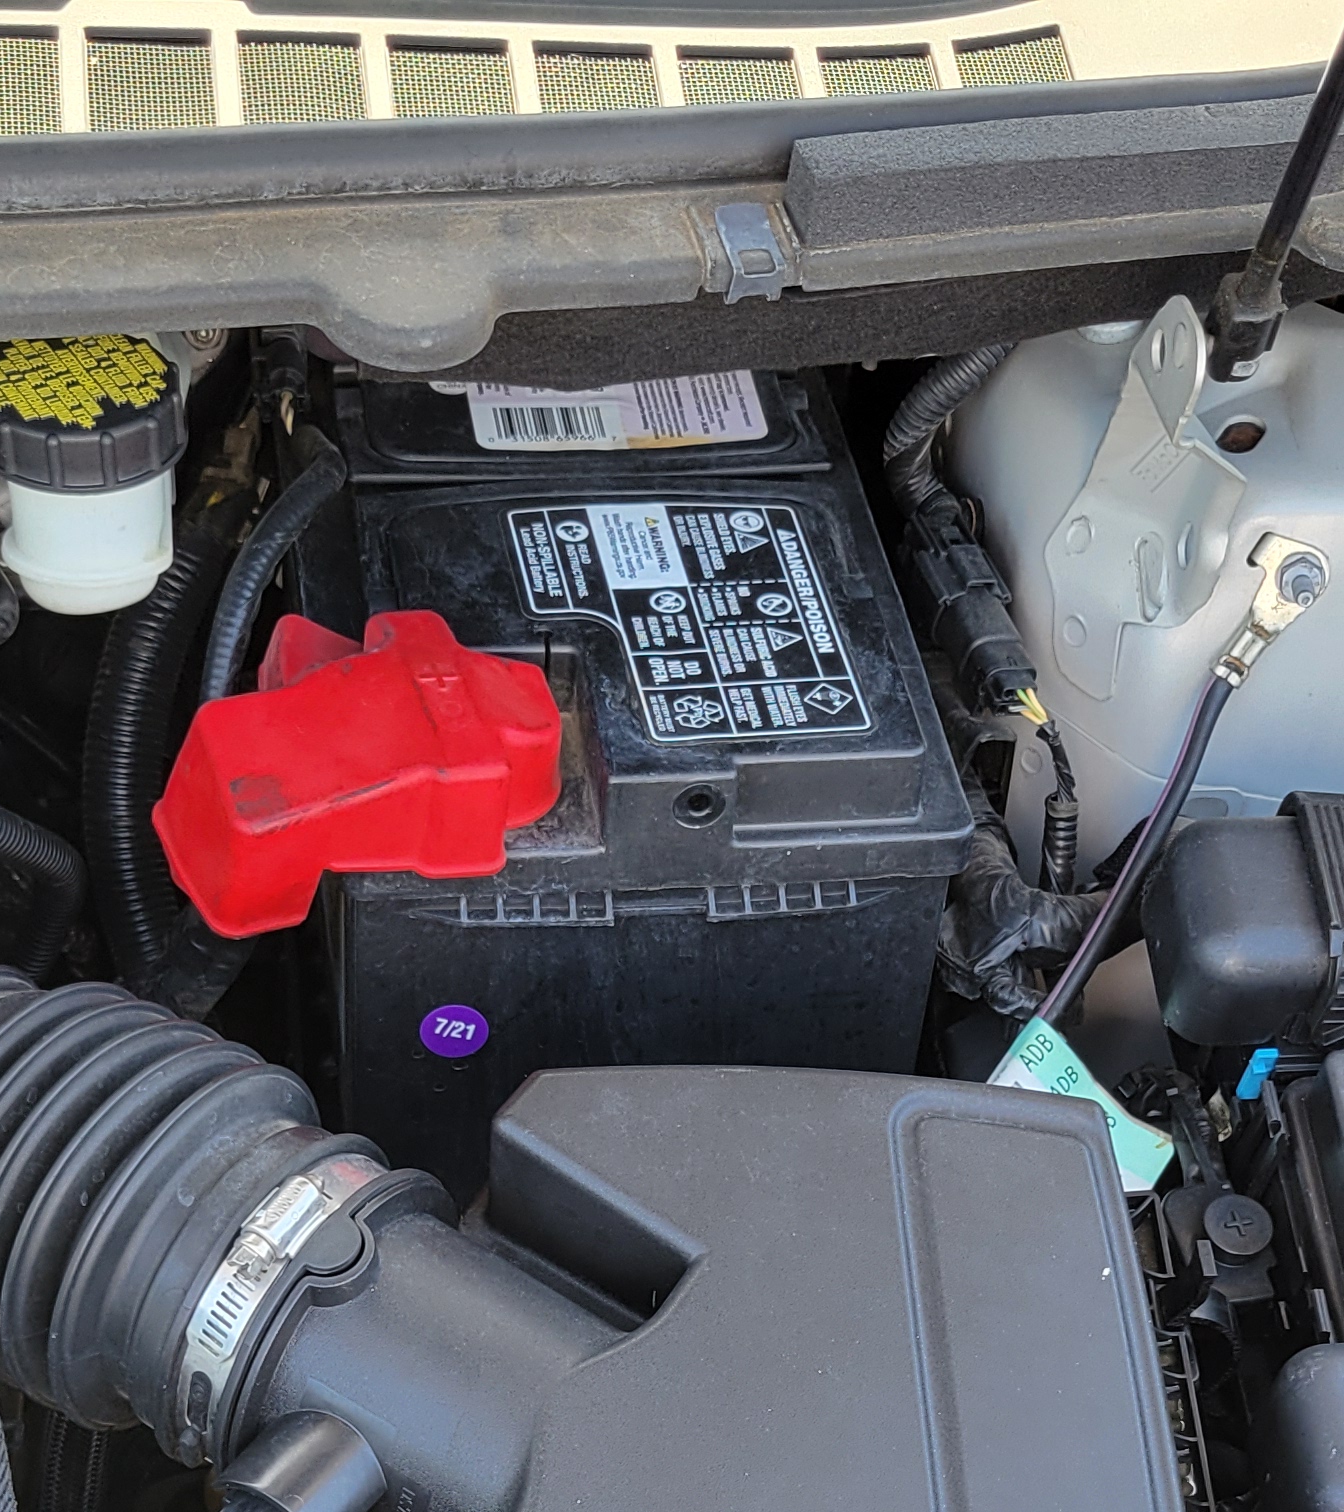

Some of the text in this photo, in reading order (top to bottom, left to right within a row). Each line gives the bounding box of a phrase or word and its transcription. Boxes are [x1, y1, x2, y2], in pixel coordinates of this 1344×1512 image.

[520, 528, 545, 594] Lead Acid Battery
[531, 523, 564, 598] NON-SPILLABLE
[577, 544, 591, 565] READ
[648, 527, 670, 573] WARNING:
[781, 541, 835, 654] DANGER/POISON
[648, 657, 669, 685] OPEN.
[666, 660, 686, 680] NOT
[683, 661, 702, 676] DO
[434, 1017, 476, 1040] 7/21
[1019, 1033, 1054, 1073] ADB
